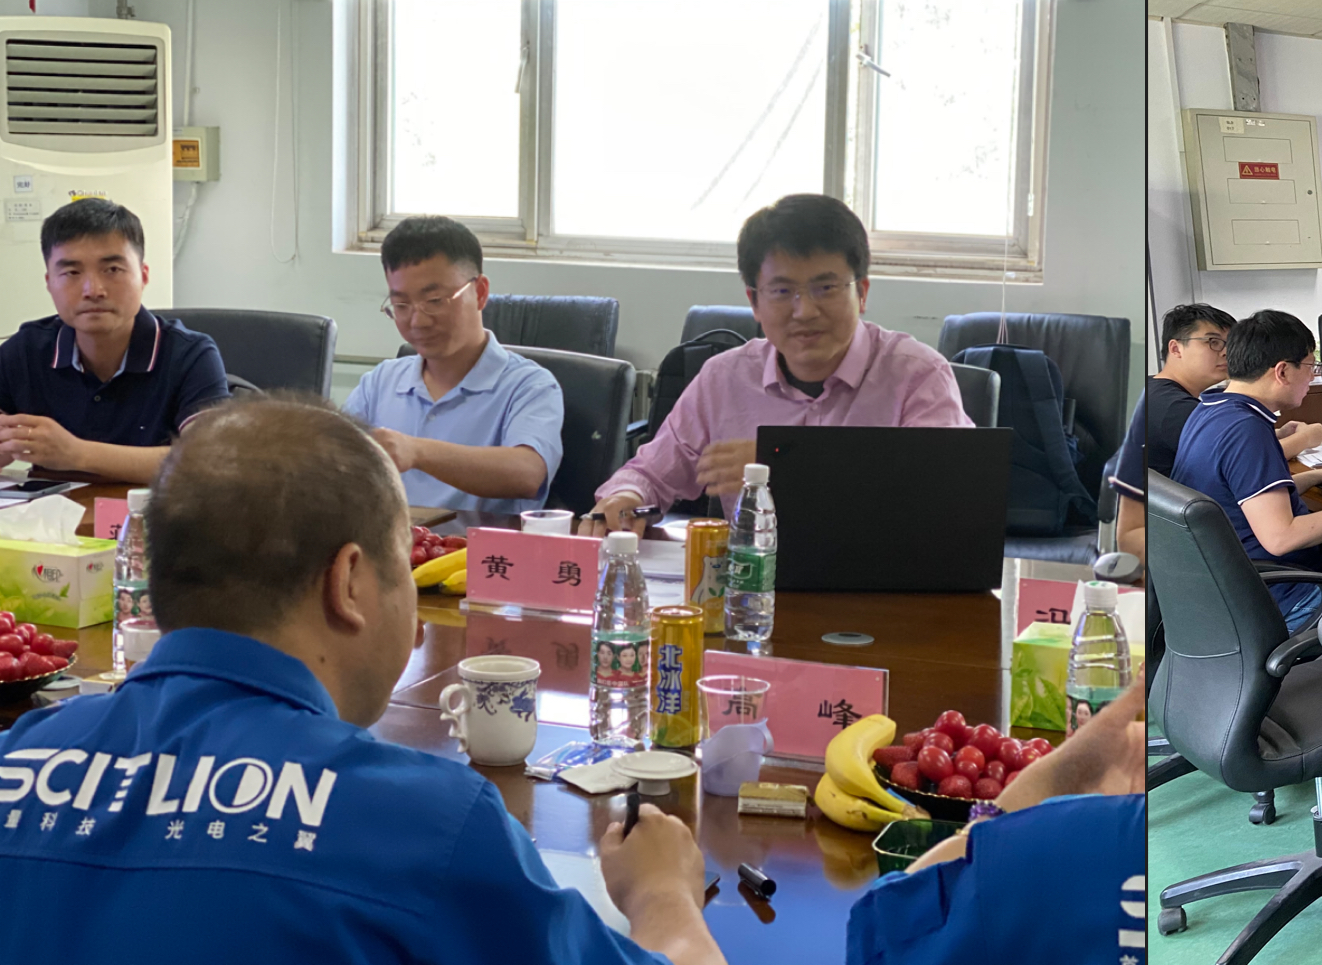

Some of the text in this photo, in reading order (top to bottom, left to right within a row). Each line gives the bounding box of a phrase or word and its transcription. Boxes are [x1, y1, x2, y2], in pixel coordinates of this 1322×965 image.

[481, 554, 582, 587] 黄勇
[656, 644, 682, 715] 北冰洋
[0, 748, 337, 827] SCITLION
[4, 809, 316, 851] 量科技 光电之翼
